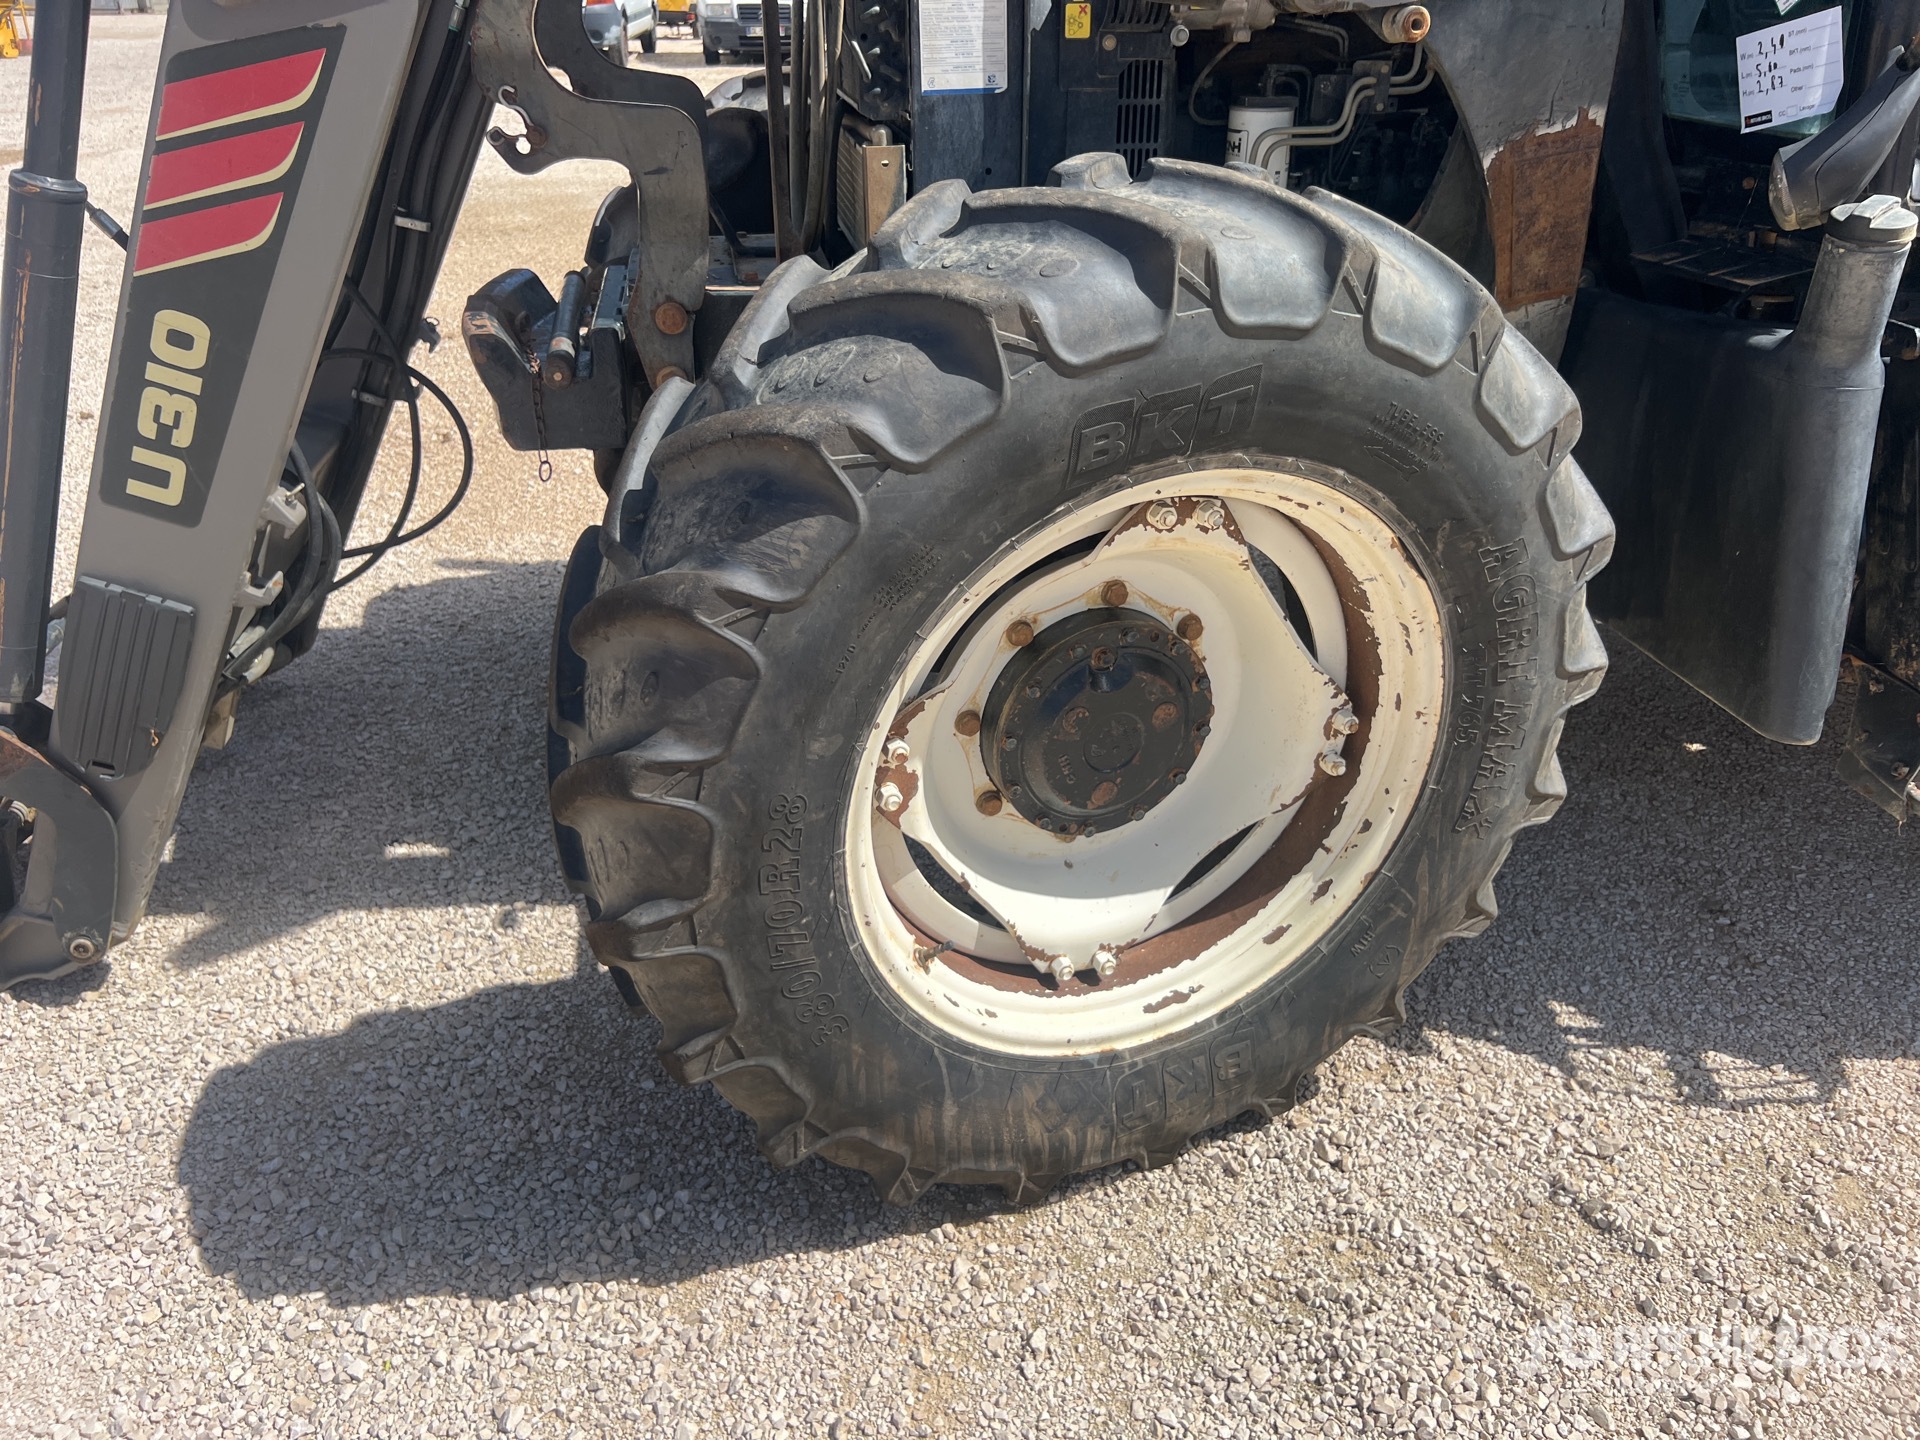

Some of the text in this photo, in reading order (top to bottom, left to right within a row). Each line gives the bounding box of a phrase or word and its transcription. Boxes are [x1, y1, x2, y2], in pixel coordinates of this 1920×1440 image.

[125, 309, 211, 507] U310
[1074, 384, 1256, 476] BKT
[1389, 401, 1445, 445] TUBELESS
[1451, 536, 1540, 841] AGRI MAX
[1453, 694, 1486, 748] 765
[1120, 1038, 1255, 1131] BKT
